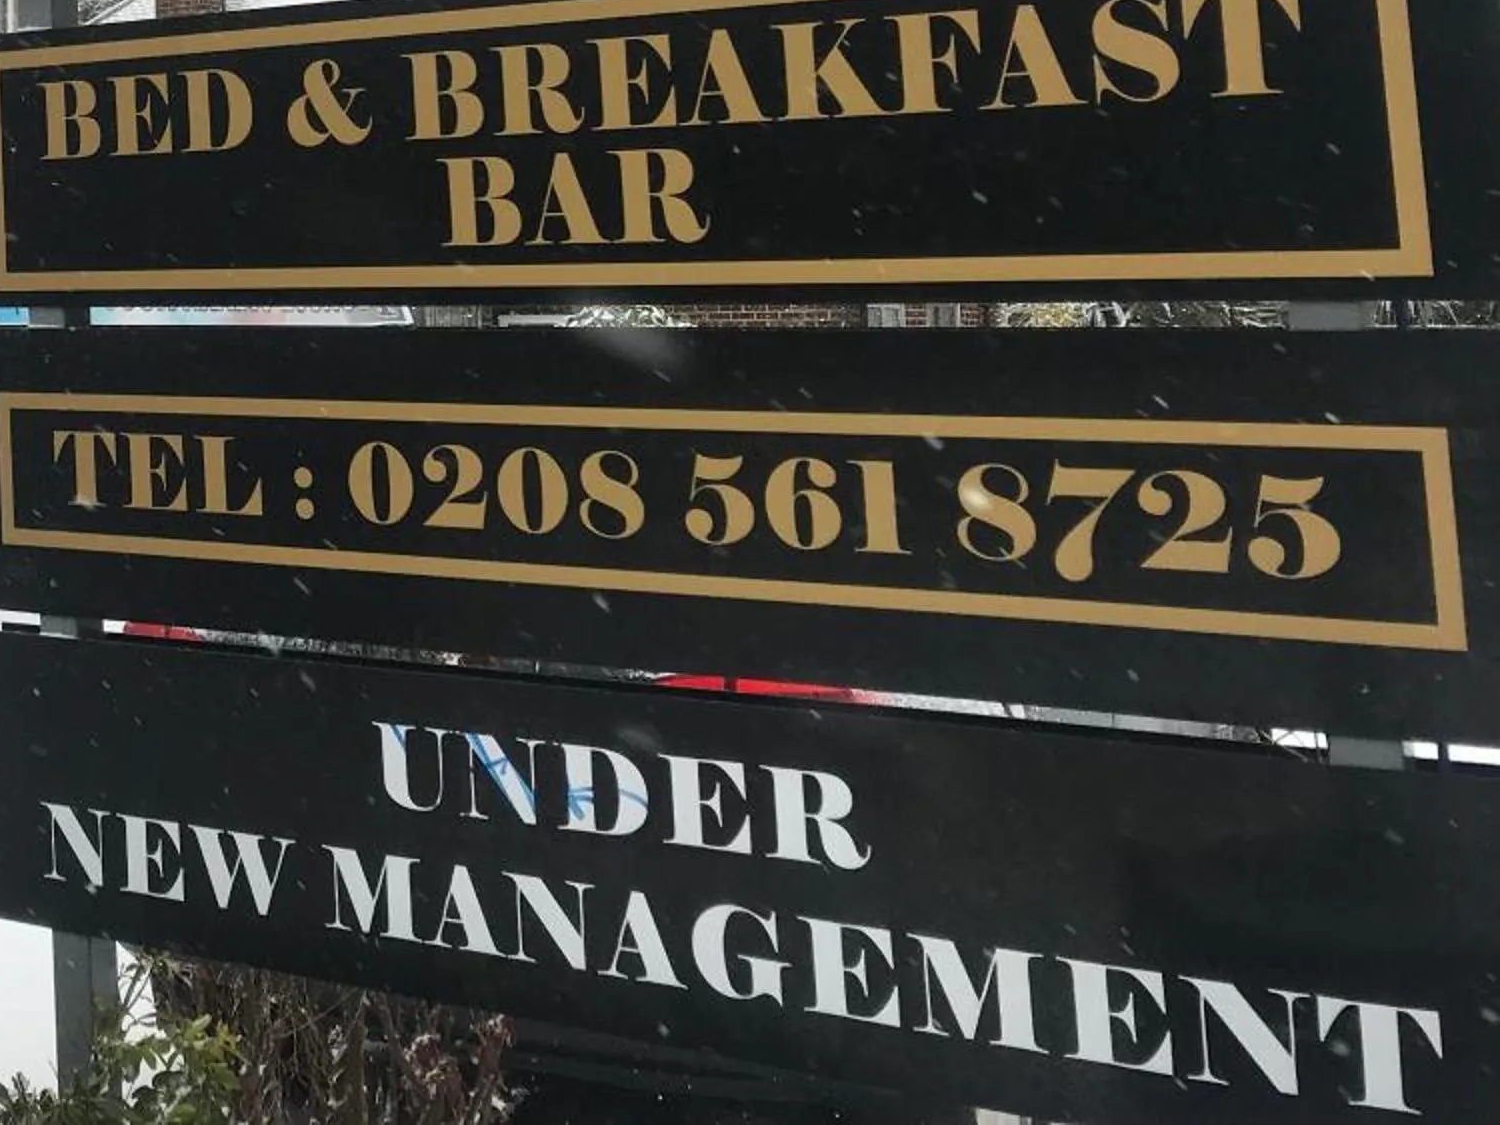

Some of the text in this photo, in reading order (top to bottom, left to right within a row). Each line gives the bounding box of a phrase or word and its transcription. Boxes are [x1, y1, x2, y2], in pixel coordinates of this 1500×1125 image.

[36, 68, 254, 161] BED
[287, 58, 373, 148] &
[436, 148, 711, 249] BAR
[347, 441, 645, 541] 0208
[684, 454, 912, 556] 561
[956, 460, 1342, 582] 8725
[371, 720, 871, 871] UNDER
[40, 802, 1443, 1116] NEW MANAGEMENT
